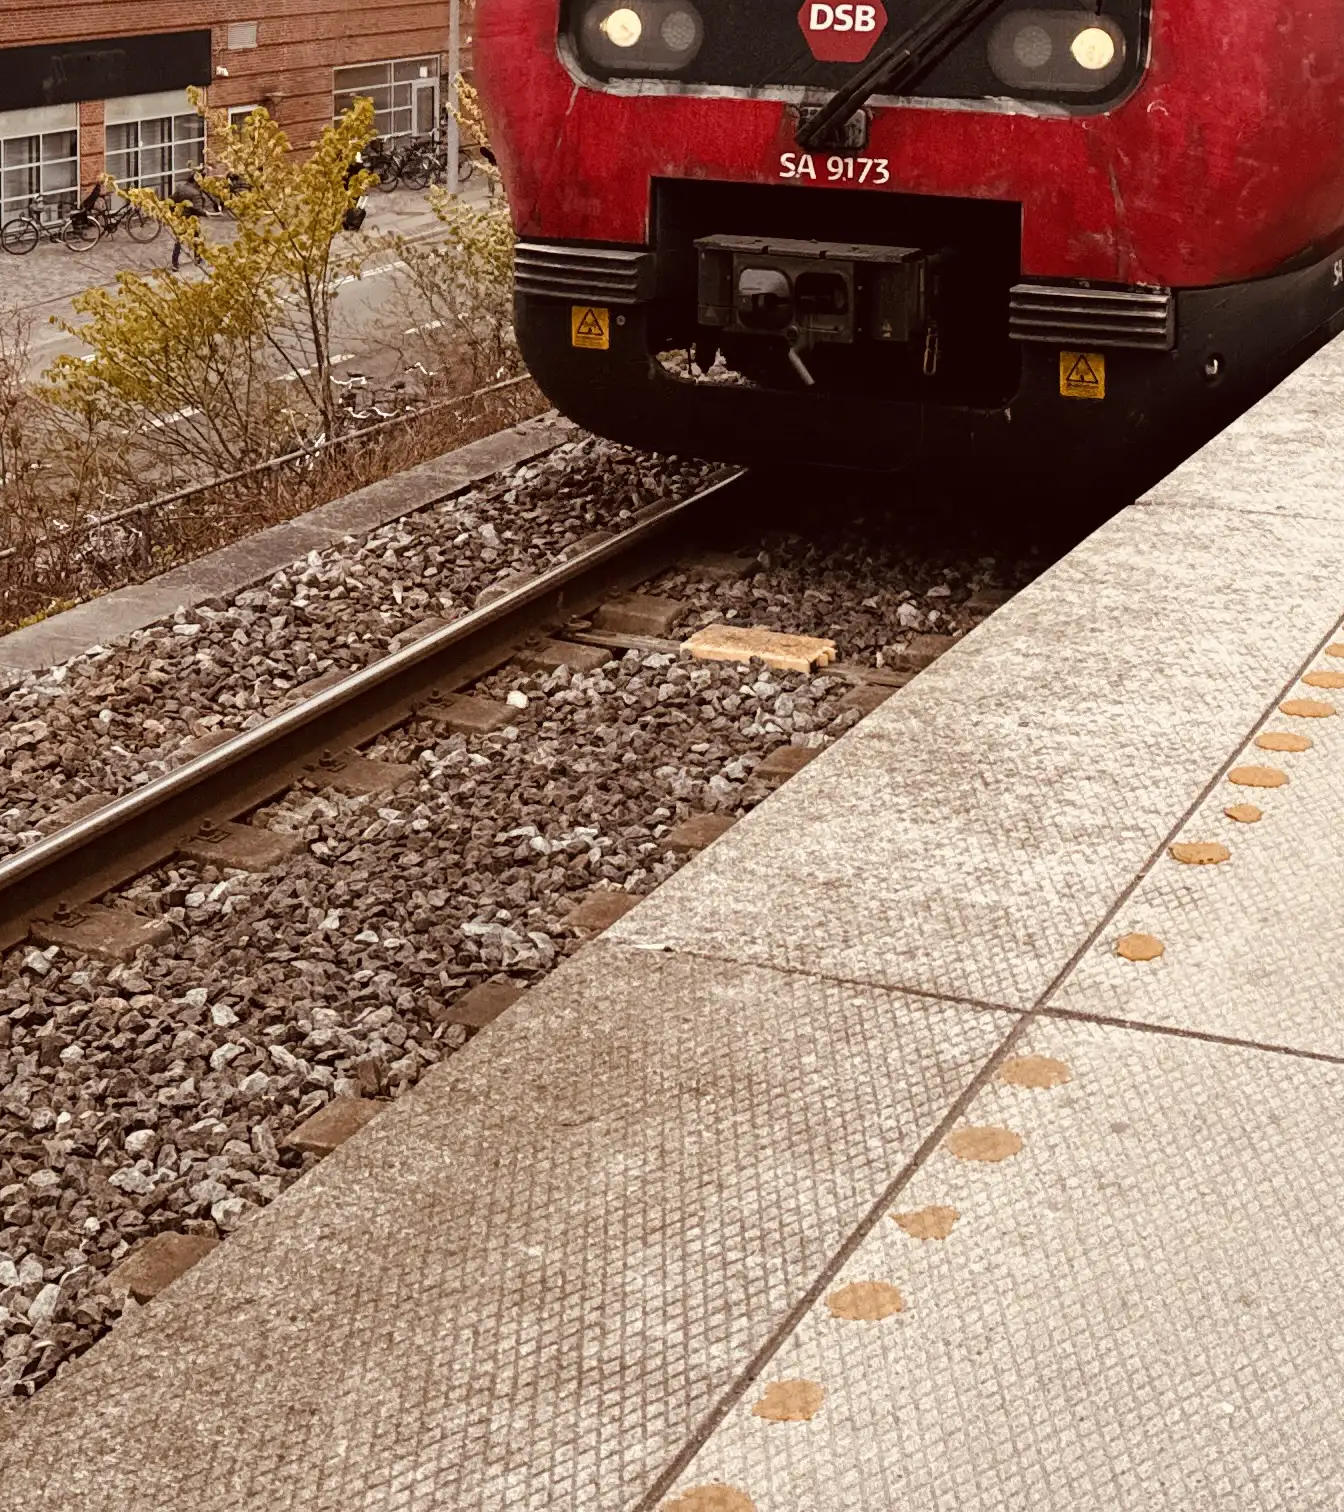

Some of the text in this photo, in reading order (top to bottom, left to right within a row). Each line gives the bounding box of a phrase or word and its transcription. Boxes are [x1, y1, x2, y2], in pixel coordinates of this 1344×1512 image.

[809, 2, 876, 33] DSB
[779, 152, 890, 185] SA 9173
